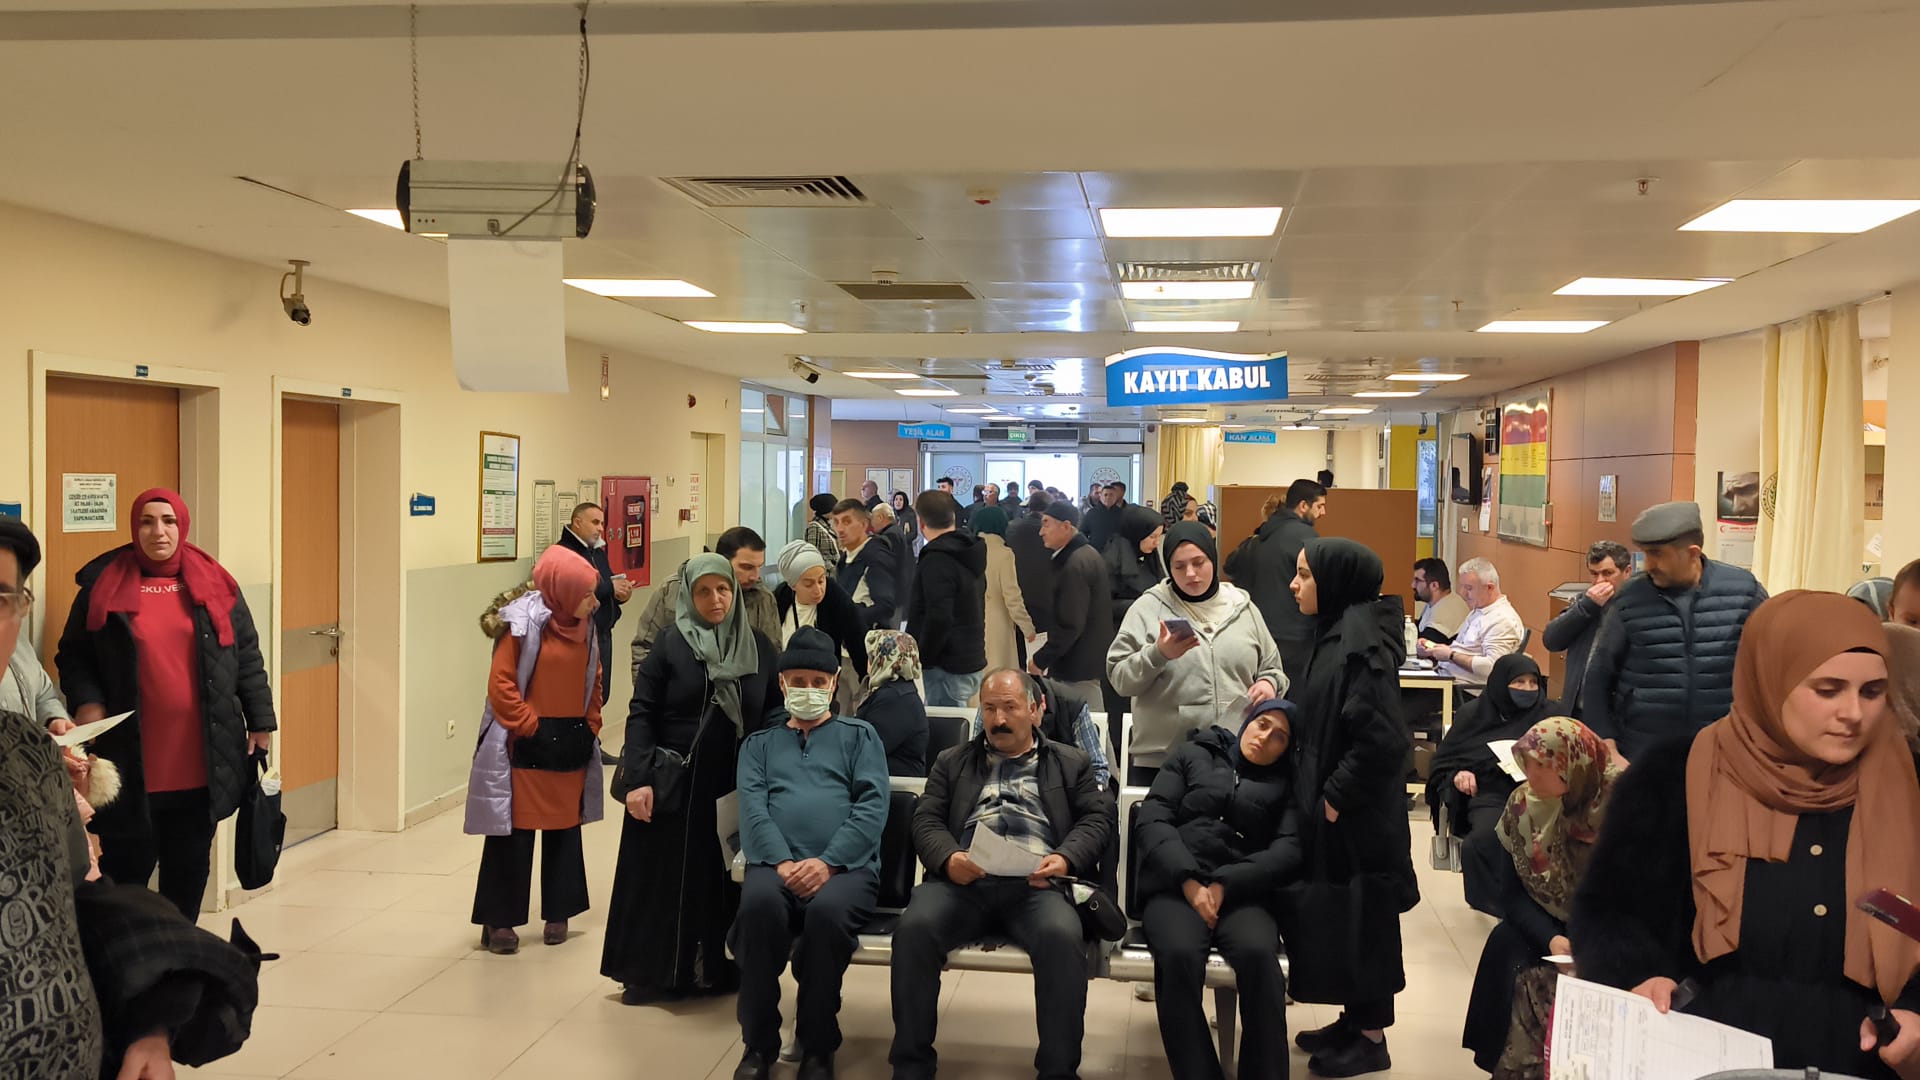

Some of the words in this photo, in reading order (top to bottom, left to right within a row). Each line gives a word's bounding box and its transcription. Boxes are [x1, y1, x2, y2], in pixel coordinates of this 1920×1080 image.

[1124, 369, 1190, 395] KAYIT
[1197, 365, 1271, 391] KABUL
[903, 427, 923, 437] YEŞİL
[925, 428, 946, 438] ALAN
[14, 967, 88, 1032] DIOR
